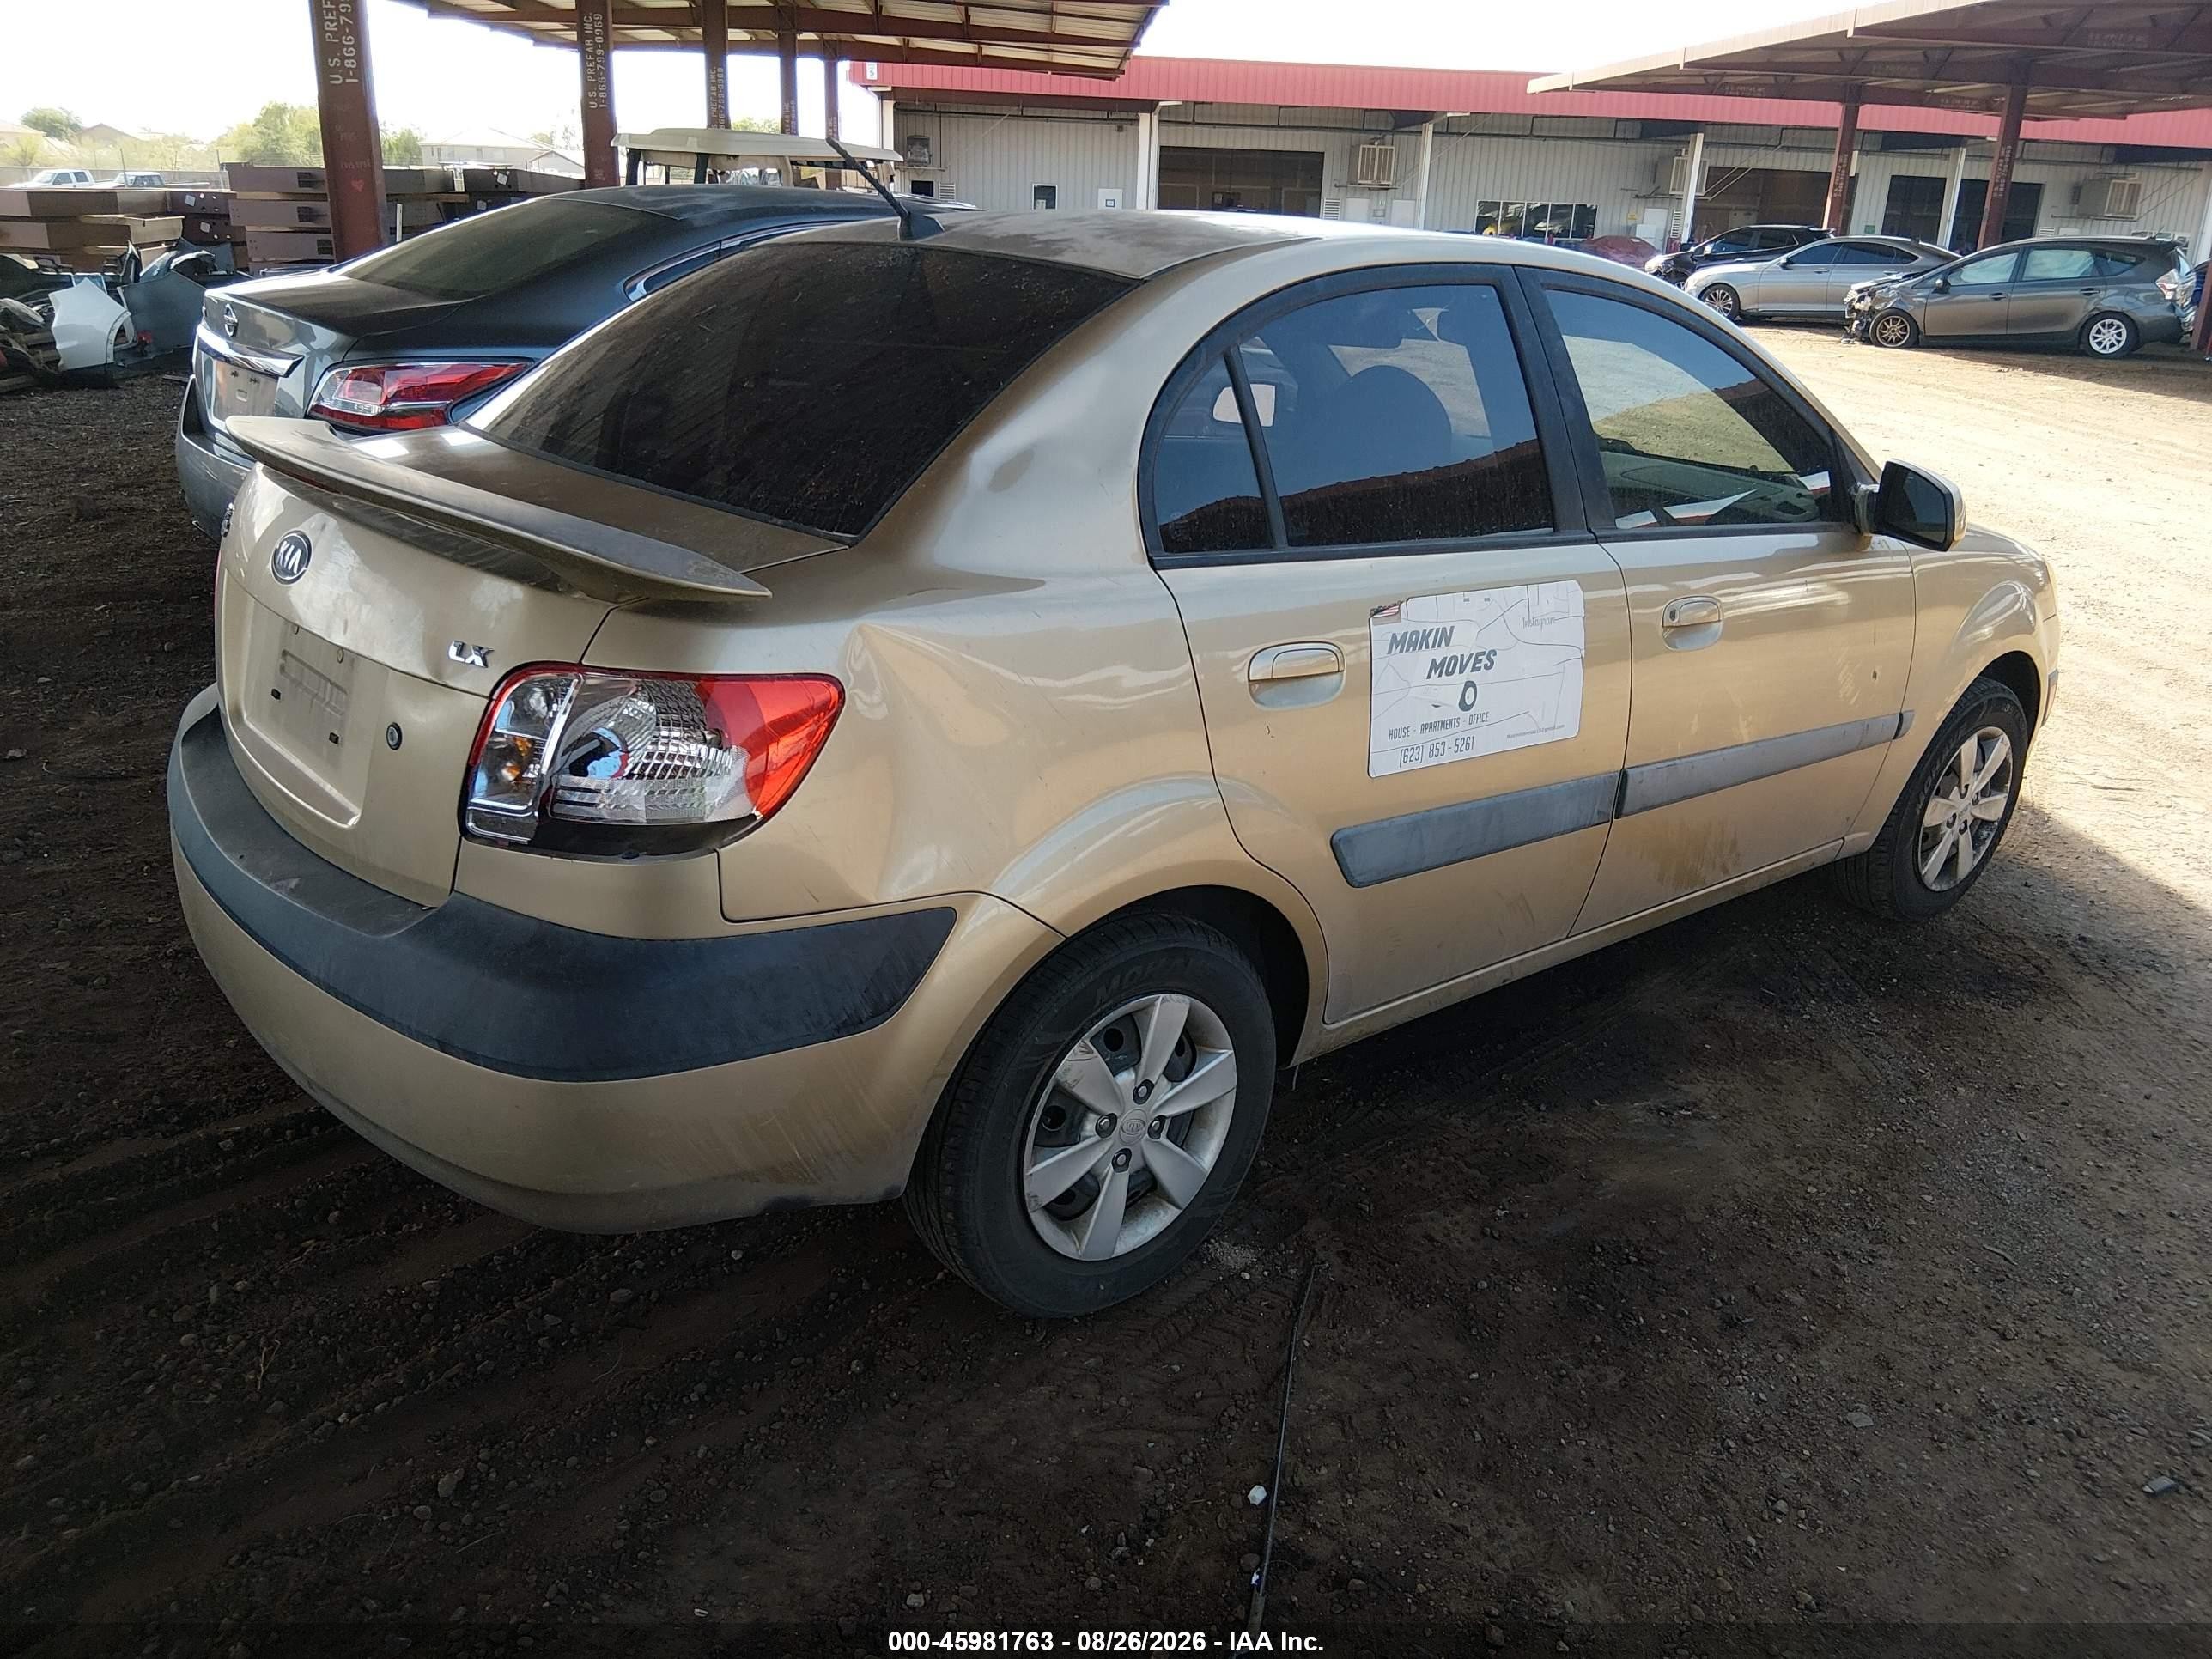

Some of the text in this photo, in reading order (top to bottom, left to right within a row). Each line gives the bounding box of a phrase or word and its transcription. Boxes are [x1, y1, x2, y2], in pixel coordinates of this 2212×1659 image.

[338, 0, 359, 83] 1-866-79
[328, 52, 343, 84] U.S.
[584, 12, 599, 109] U.S. PREFAB INC.
[276, 540, 302, 574] KIA
[448, 640, 495, 668] LX
[1387, 625, 1455, 654] MAKIN
[1426, 649, 1497, 679] MOVES
[1389, 726, 1410, 741] HOUSE
[1419, 717, 1461, 735] APARTMENTS
[1468, 712, 1490, 726] OFFICE
[1428, 741, 1446, 758] 853
[1454, 736, 1475, 754] 5261
